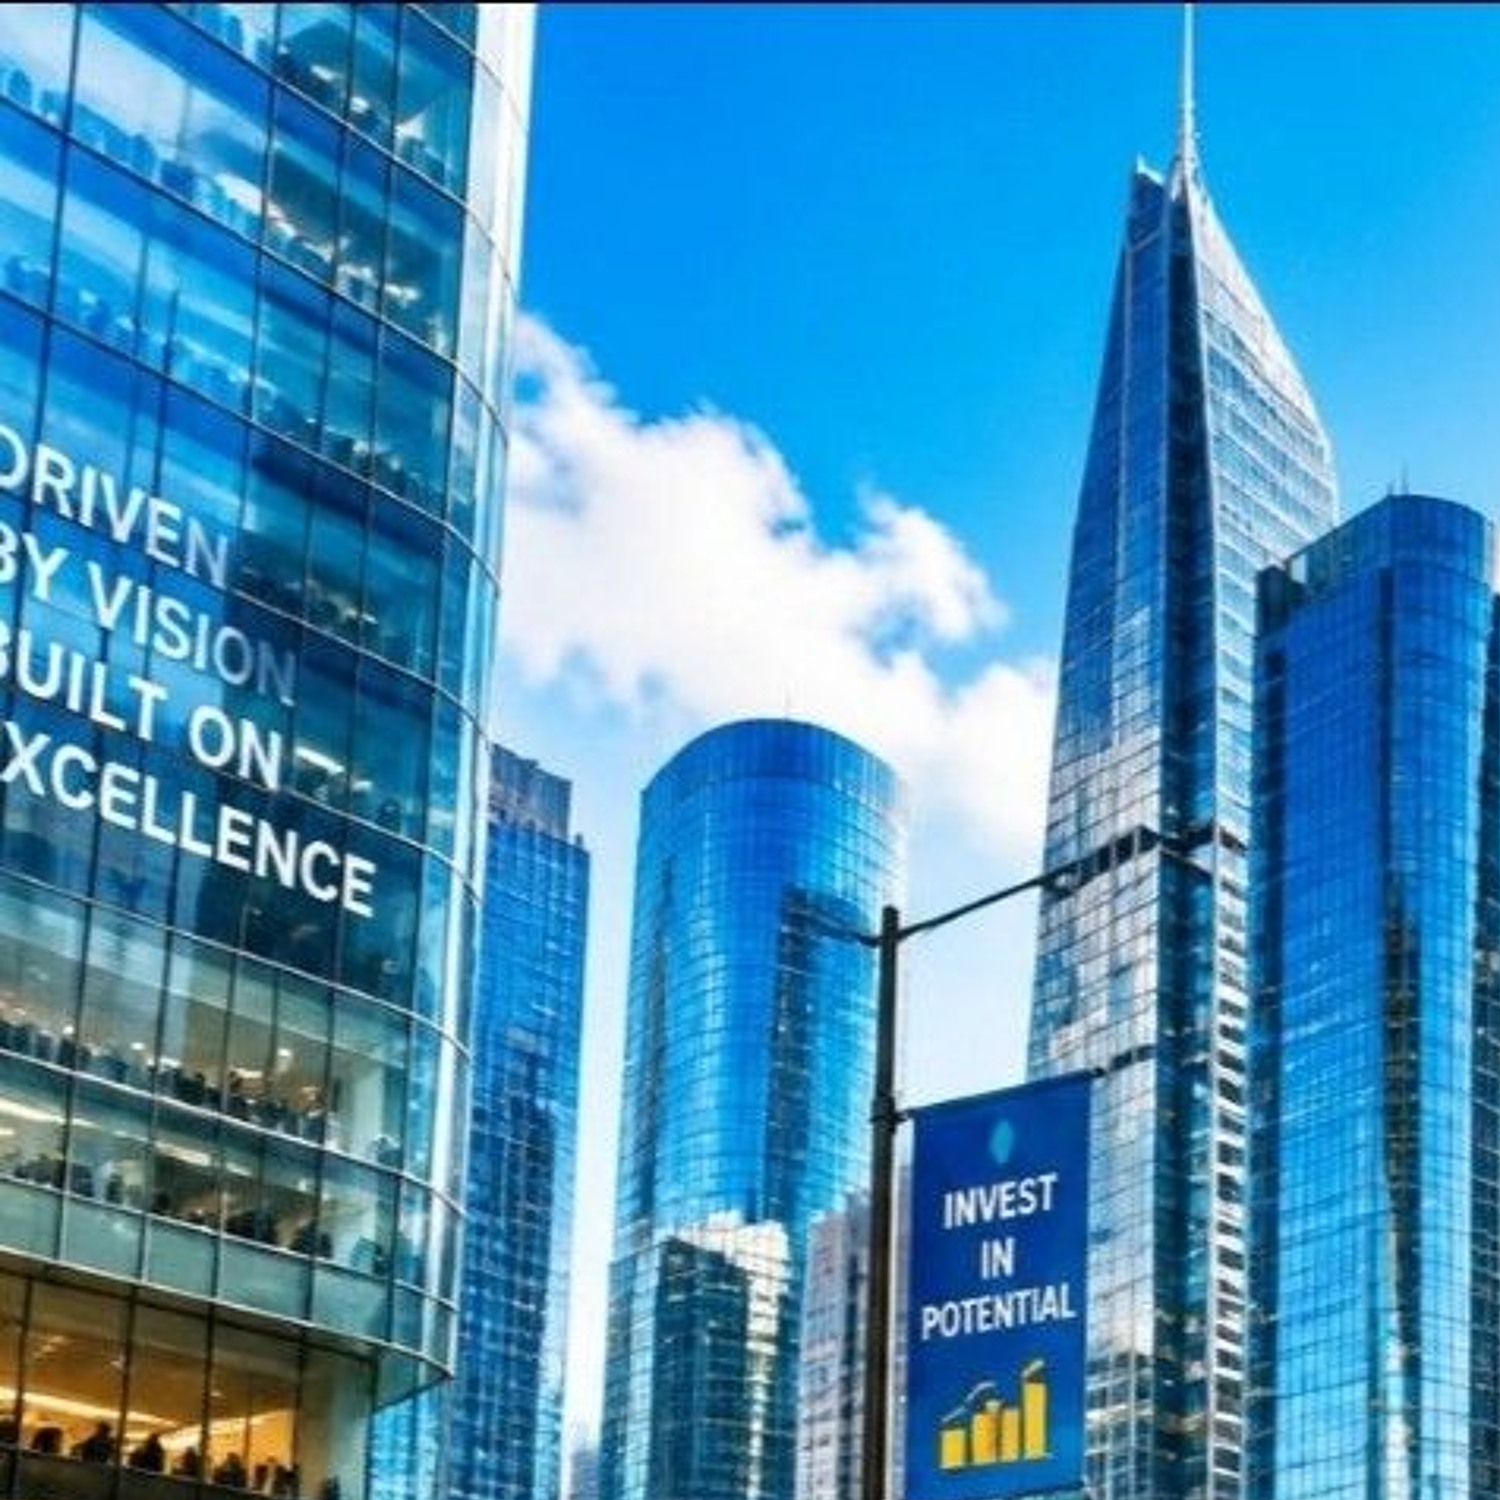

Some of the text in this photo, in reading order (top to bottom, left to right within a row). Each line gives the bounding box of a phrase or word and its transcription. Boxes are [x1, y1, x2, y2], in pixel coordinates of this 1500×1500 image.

[88, 561, 295, 706] VISION
[188, 706, 282, 791] ON
[0, 719, 377, 918] XCELLENCE
[943, 1173, 1058, 1230] INVEST
[981, 1237, 1016, 1280] IN
[922, 1283, 1077, 1341] POTENTIAL
